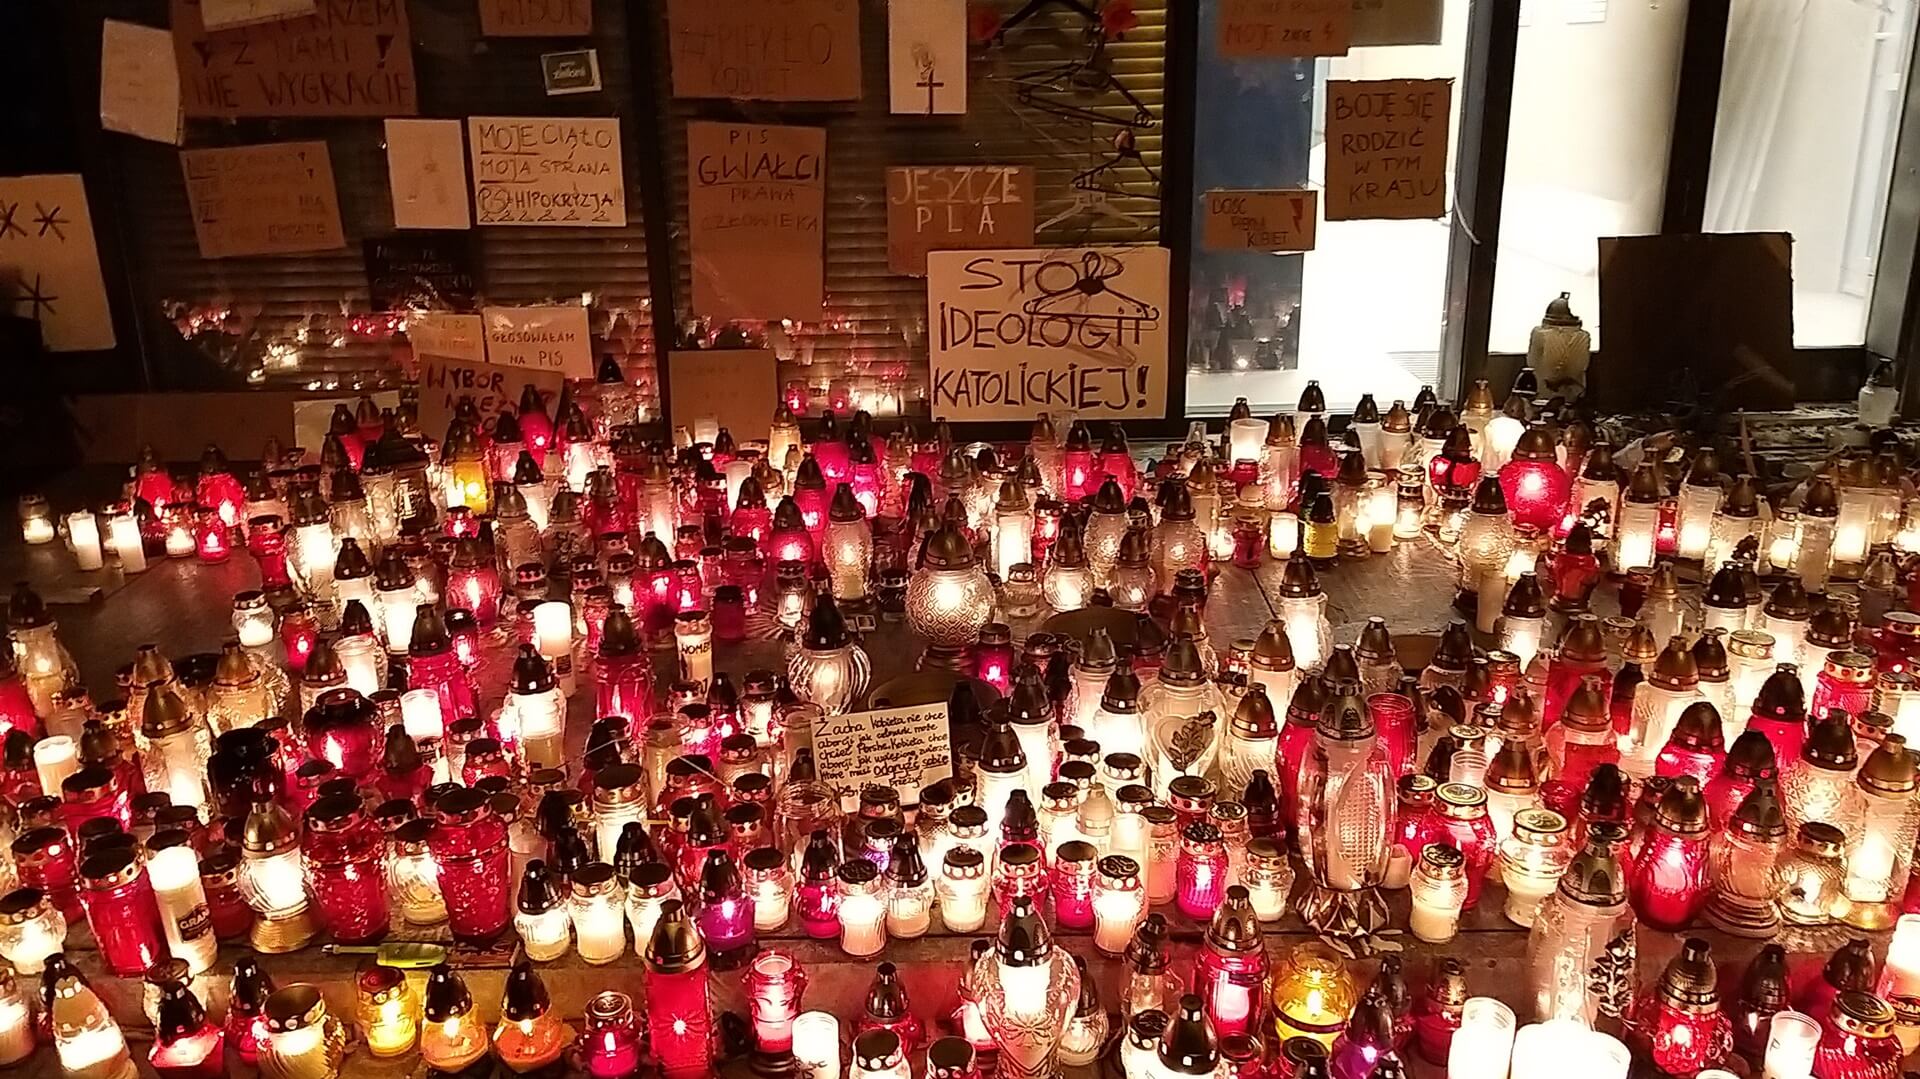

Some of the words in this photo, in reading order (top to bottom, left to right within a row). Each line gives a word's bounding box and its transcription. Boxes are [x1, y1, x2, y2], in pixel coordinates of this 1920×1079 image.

[192, 73, 239, 108] NIE
[1335, 92, 1397, 123] BOJĘ
[1402, 92, 1434, 123] SIĘ
[479, 123, 539, 152] MOJE
[729, 129, 769, 145] PIS
[1341, 127, 1425, 156] RODZIĆ
[479, 159, 532, 181] MOJA
[697, 151, 820, 184] GWAŁCI
[1354, 160, 1370, 175] W
[1381, 156, 1421, 172] TYM
[888, 167, 1022, 206] JESZCZE
[1348, 178, 1440, 205] KRAJU
[959, 254, 1124, 296] STOP
[491, 331, 577, 343] GŁOSOWAŁAM
[509, 355, 526, 365] NA
[814, 717, 866, 738] Żadna
[907, 713, 922, 723] nie
[923, 711, 946, 721] chce
[928, 733, 949, 743] chce
[858, 734, 873, 744] jak
